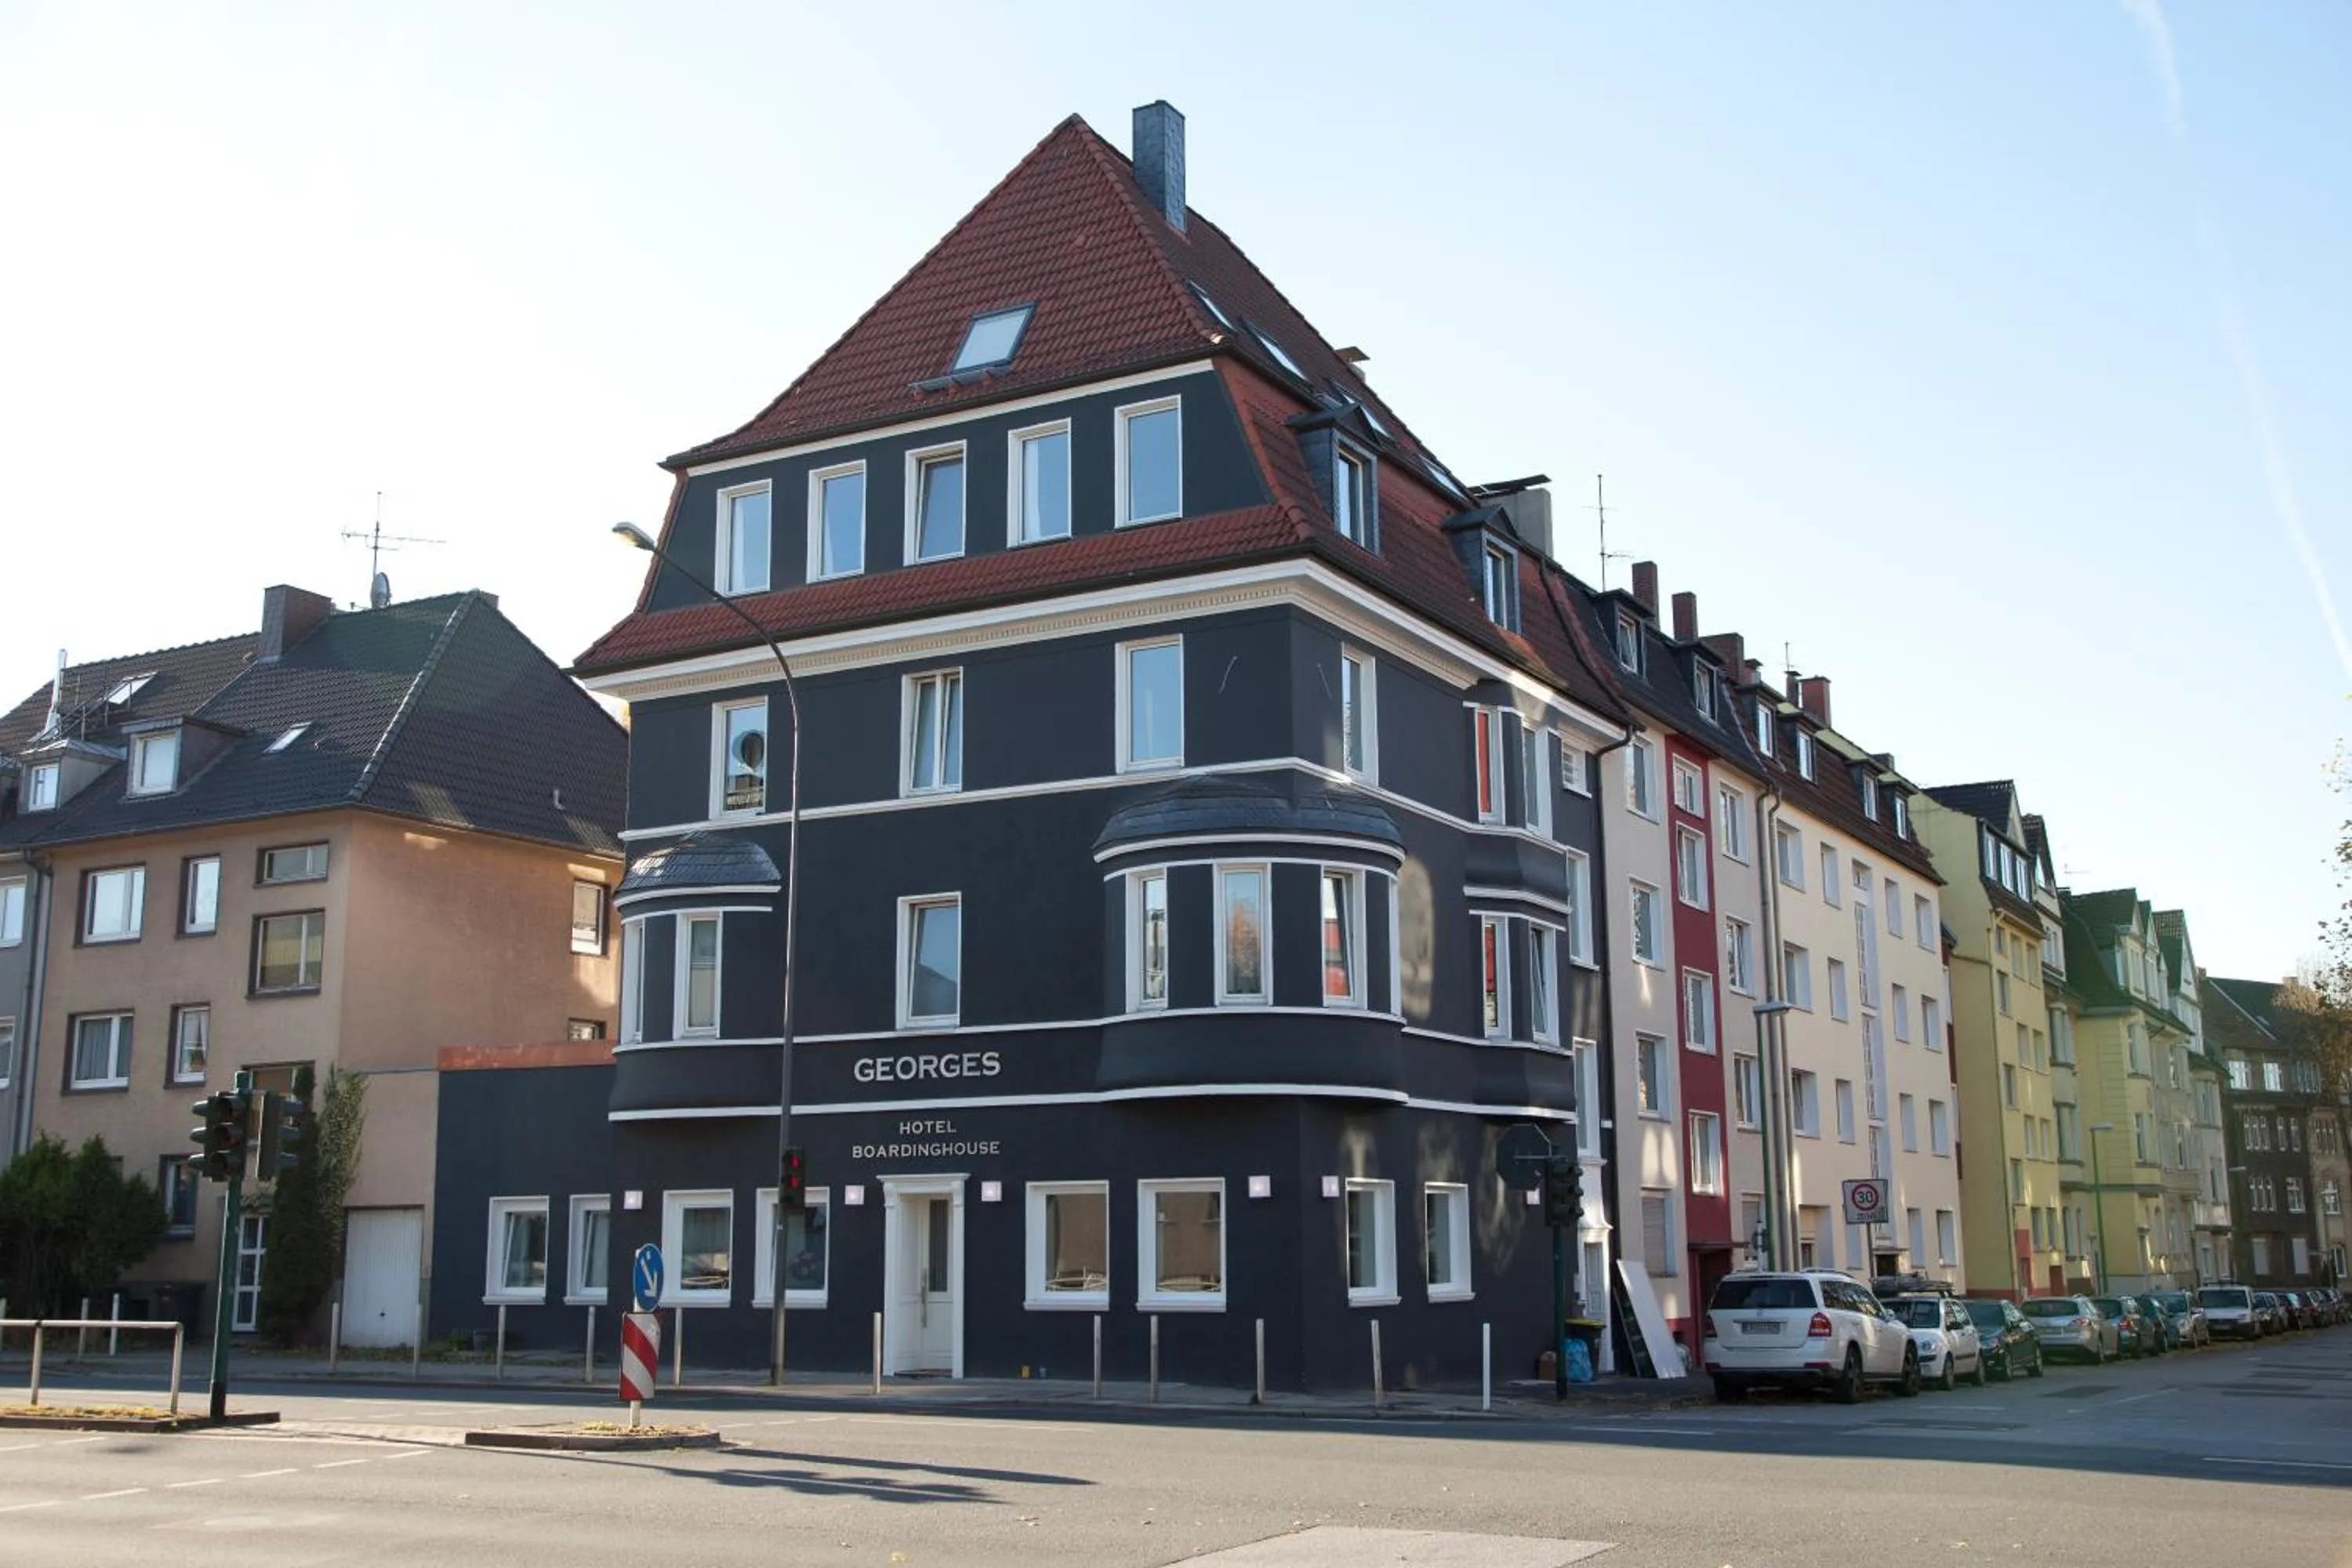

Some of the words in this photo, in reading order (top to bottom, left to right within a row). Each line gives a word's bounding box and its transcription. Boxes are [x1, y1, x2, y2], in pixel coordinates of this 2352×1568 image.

[854, 1051, 1001, 1082] GEORGES
[899, 1120, 956, 1134] HOTEL
[852, 1141, 1000, 1158] BOARDINGHOUSE
[1857, 1191, 1873, 1203] 30
